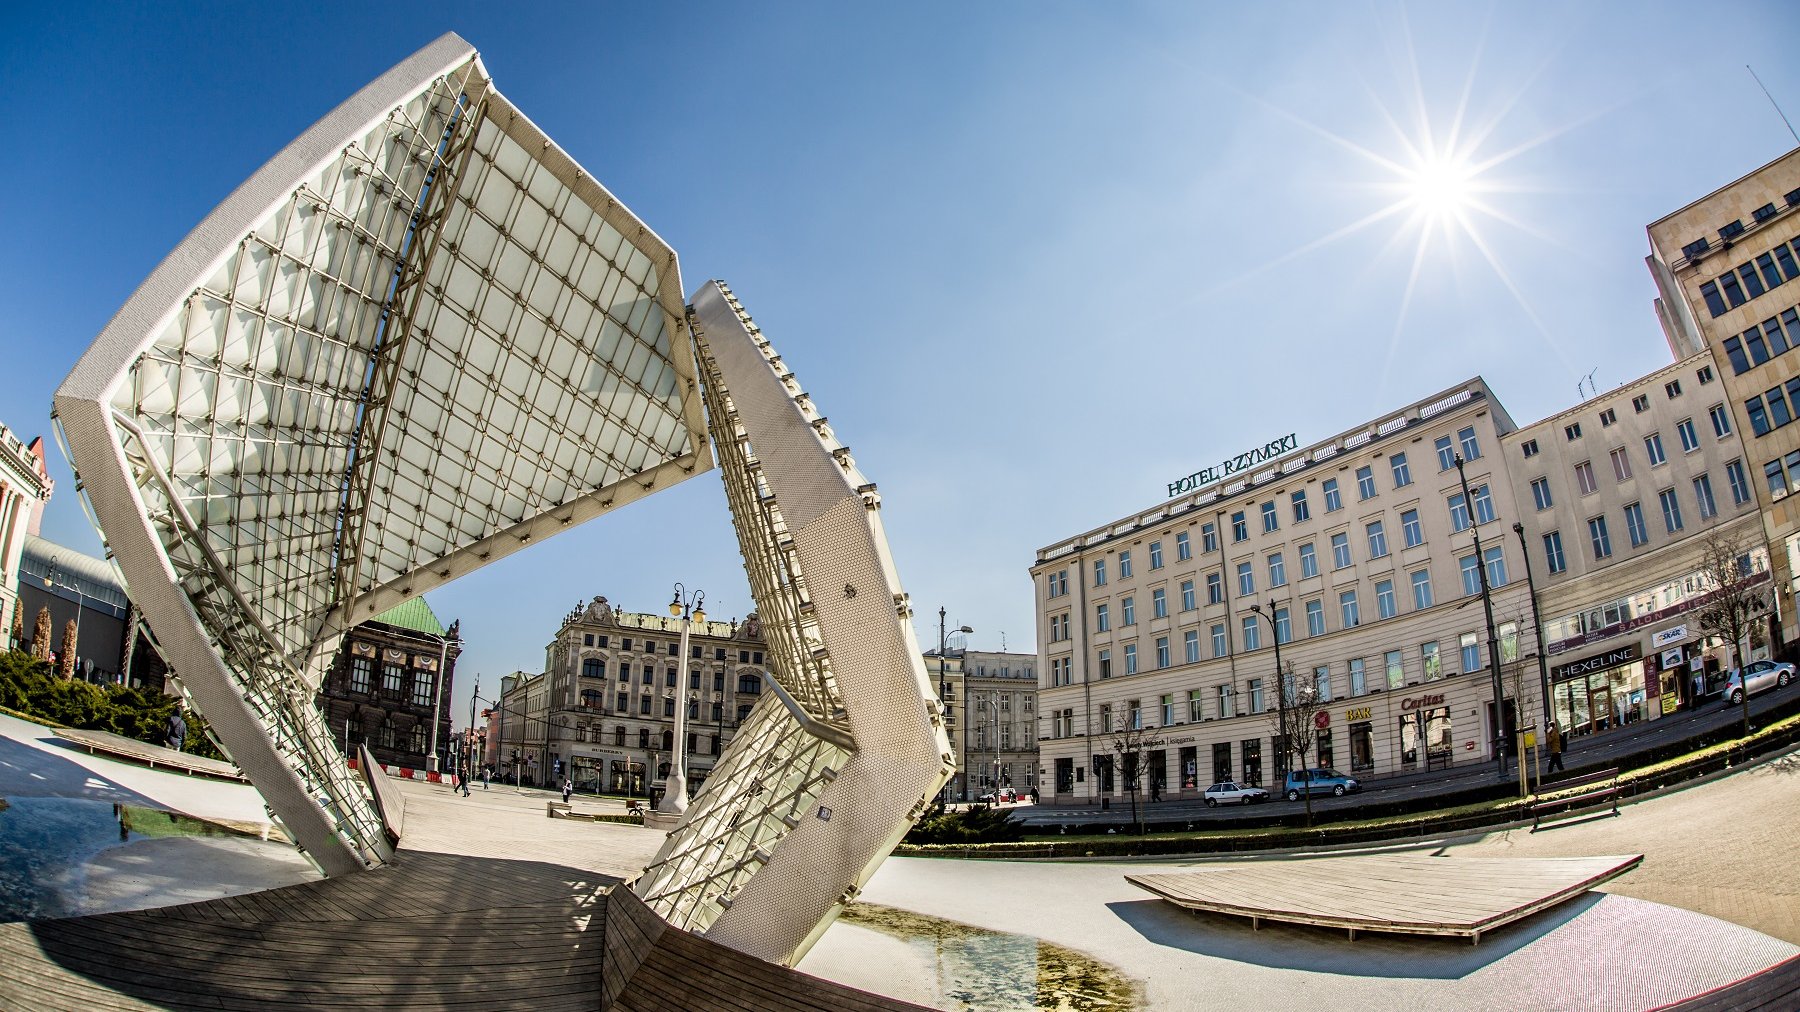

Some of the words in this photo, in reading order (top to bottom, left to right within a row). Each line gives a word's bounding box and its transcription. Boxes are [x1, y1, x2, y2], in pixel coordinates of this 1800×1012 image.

[1167, 467, 1220, 497] HOTEL
[1223, 433, 1298, 476] RZYMSKI
[1619, 612, 1663, 631] SALON
[1560, 648, 1634, 678] HEXELINE
[620, 683, 721, 700] BAZAR
[1401, 693, 1445, 711] Caritas
[1345, 707, 1372, 721] BAR
